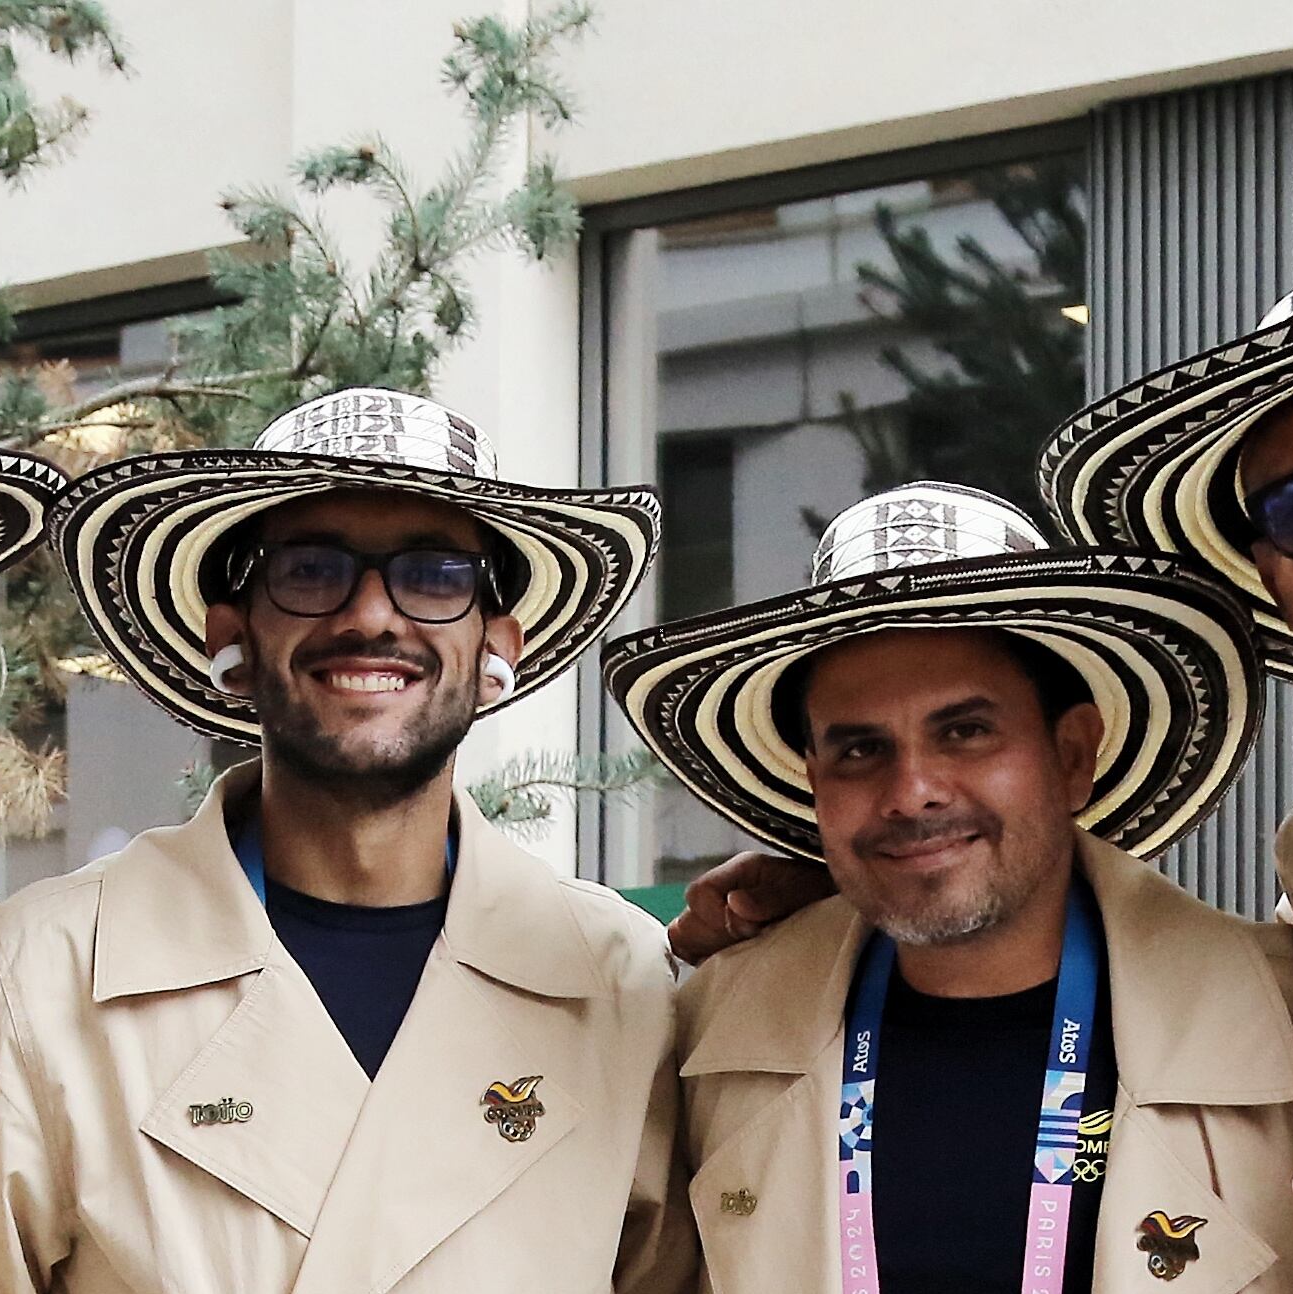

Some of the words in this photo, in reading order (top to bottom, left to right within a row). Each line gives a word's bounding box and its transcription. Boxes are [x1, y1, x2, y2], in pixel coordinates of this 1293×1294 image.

[852, 1030, 871, 1073] Atos
[1058, 1018, 1081, 1065] Atos
[846, 1206, 866, 1276] 2024
[1034, 1199, 1058, 1278] PARIS
